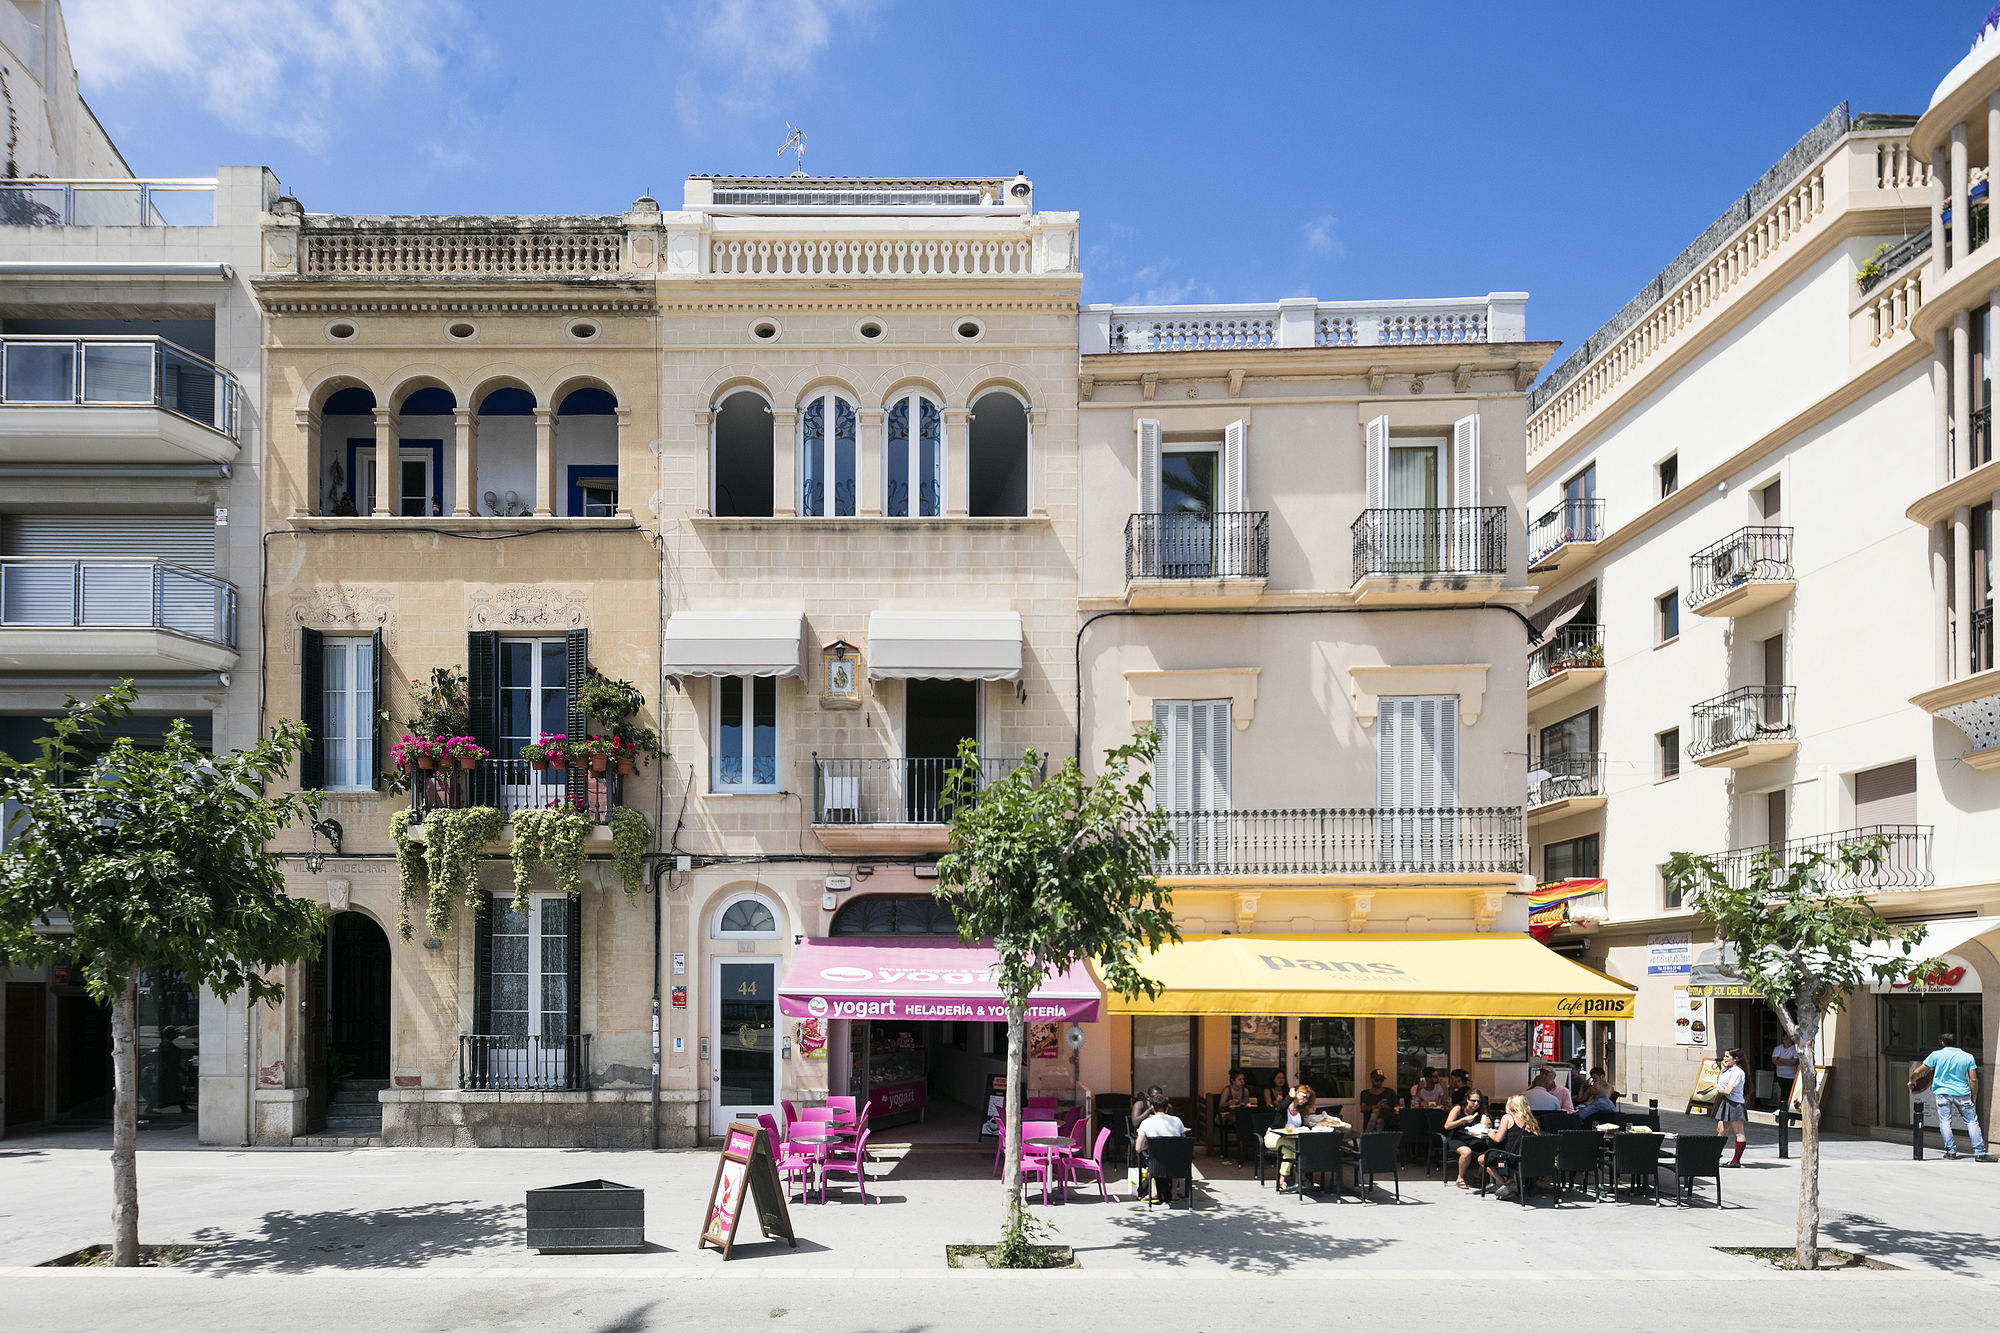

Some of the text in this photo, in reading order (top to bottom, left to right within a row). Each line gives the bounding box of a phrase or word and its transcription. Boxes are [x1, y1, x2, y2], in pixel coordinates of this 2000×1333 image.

[293, 863, 387, 873] VIL CANDELARIA
[1258, 954, 1406, 975] pans
[738, 981, 757, 995] 44
[1714, 987, 1725, 996] SOL
[1726, 986, 1740, 996] DEL
[833, 1000, 896, 1017] yogart
[905, 1003, 973, 1016] HELADERÍA
[976, 1006, 985, 1016] &
[1584, 999, 1625, 1015] pans
[888, 1088, 915, 1109] yogart
